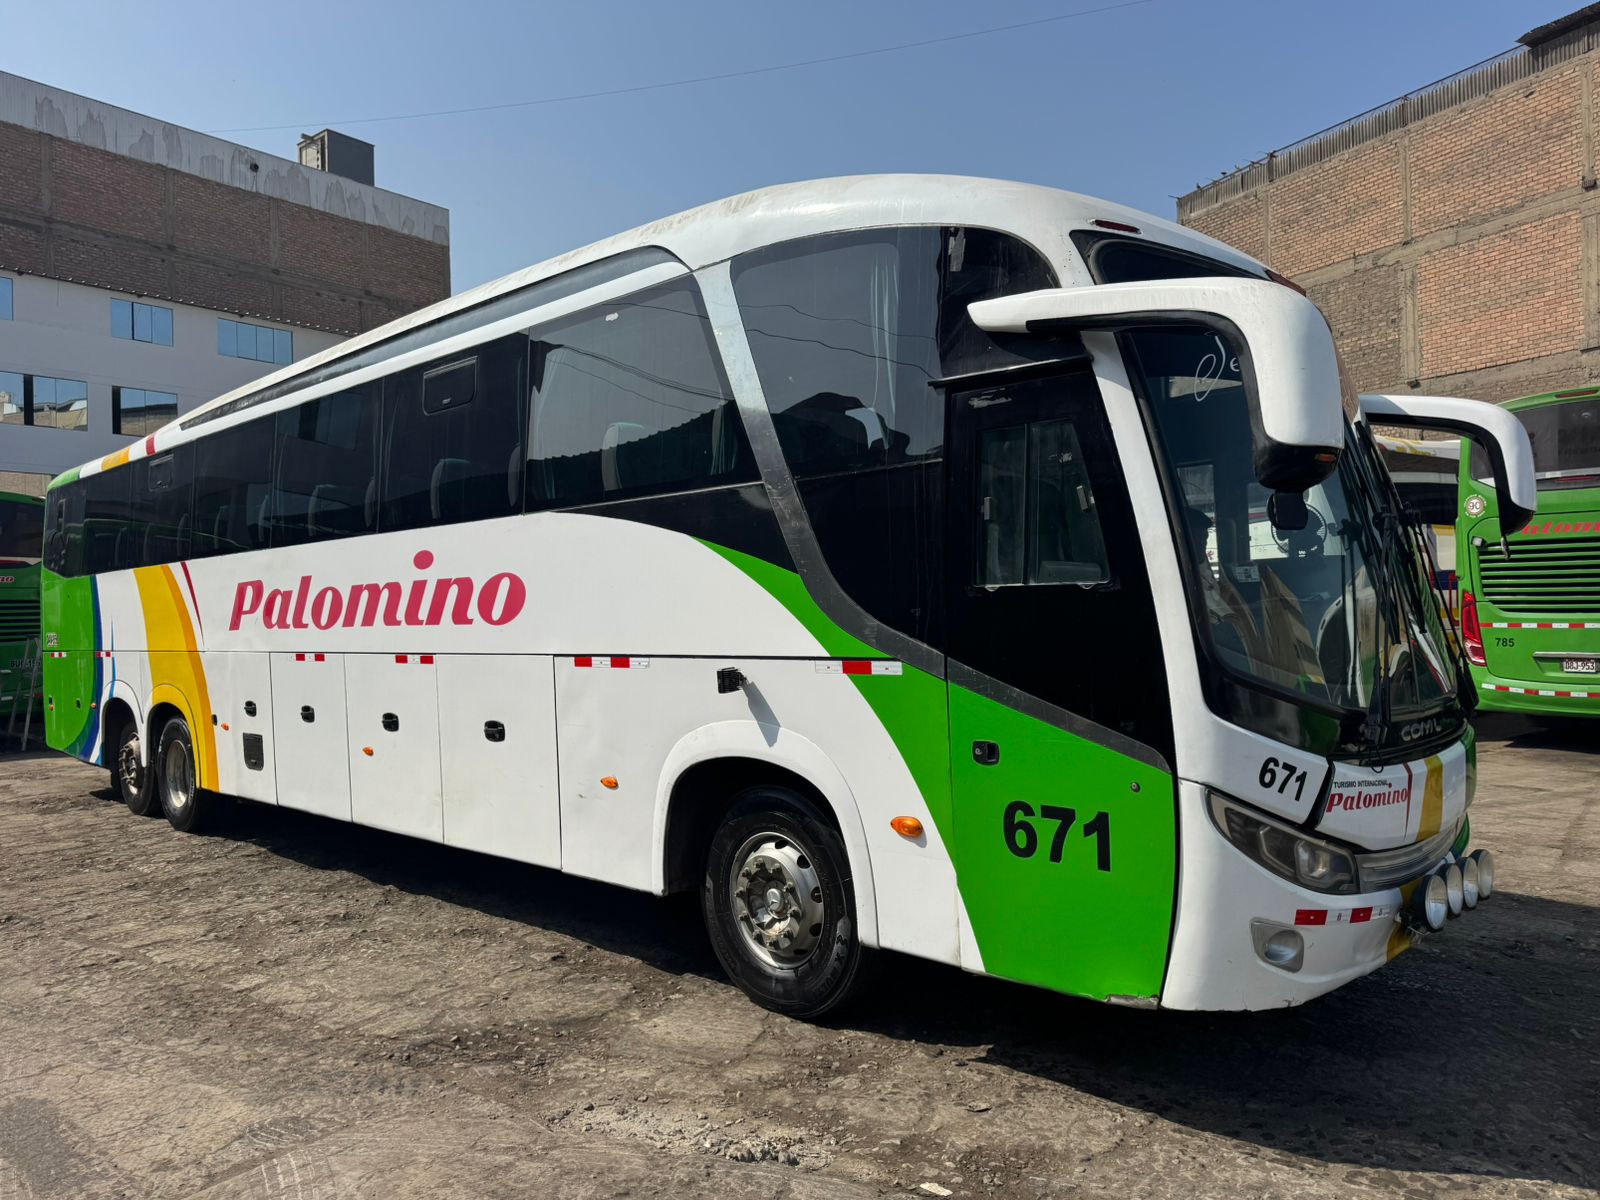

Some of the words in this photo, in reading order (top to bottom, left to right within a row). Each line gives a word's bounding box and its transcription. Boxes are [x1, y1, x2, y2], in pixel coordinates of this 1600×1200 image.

[228, 549, 527, 631] Palomino
[1495, 637, 1515, 648] 785
[1258, 757, 1308, 802] 671
[1325, 782, 1408, 813] Palomino
[1333, 780, 1357, 789] TURISMO
[1357, 779, 1389, 788] INTERNACIONAL
[1003, 800, 1112, 872] 671
